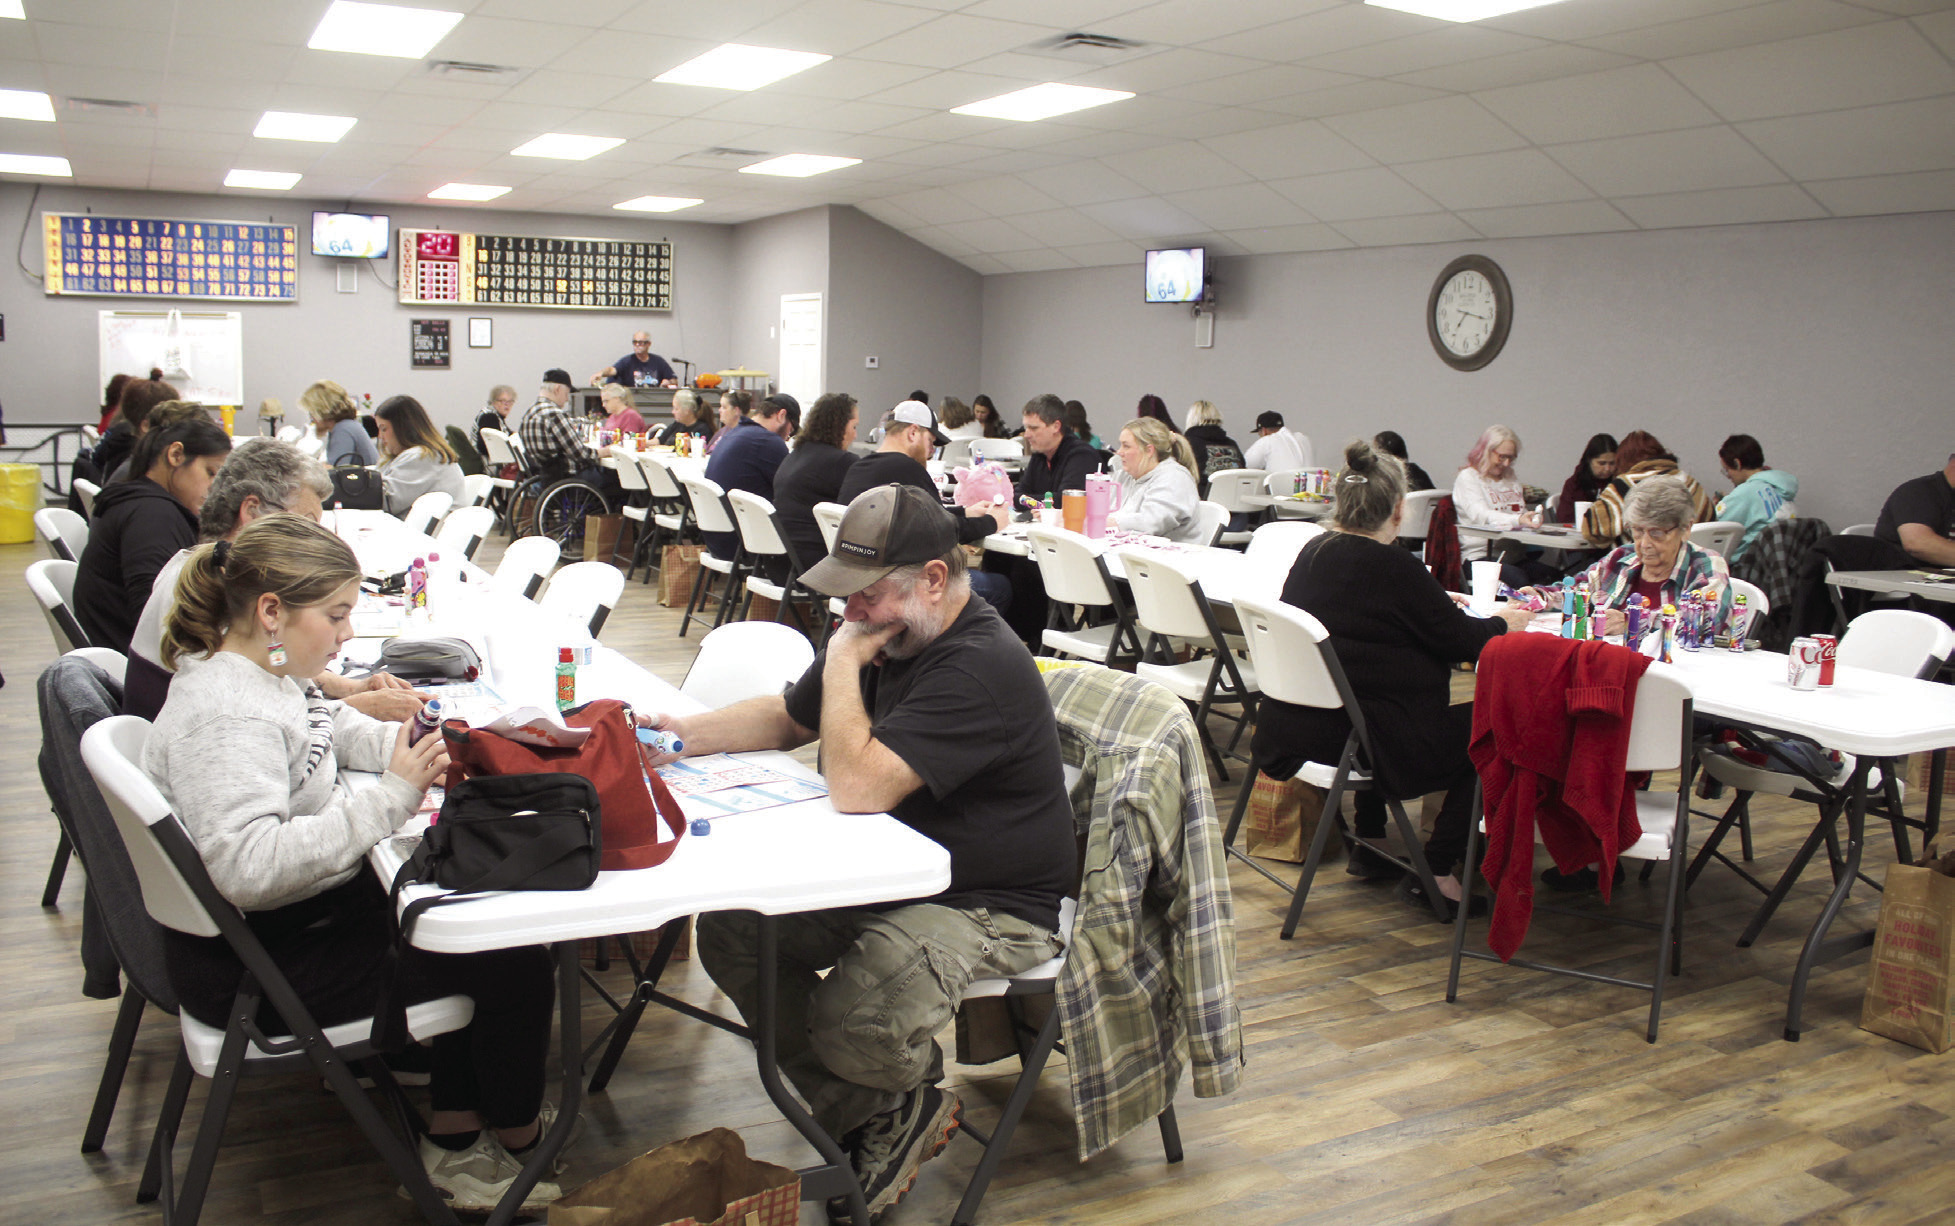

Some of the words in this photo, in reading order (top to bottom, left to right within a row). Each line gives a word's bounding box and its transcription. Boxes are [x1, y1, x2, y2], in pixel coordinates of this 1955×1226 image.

[329, 239, 352, 254] 64
[421, 232, 452, 254] 20
[481, 237, 486, 247] 1
[493, 238, 499, 248] 2
[507, 238, 512, 249] 3
[520, 239, 525, 249] 4
[533, 240, 538, 250] 5
[547, 240, 553, 250] 6
[560, 241, 566, 251] 7
[586, 242, 592, 252] 9
[597, 242, 607, 253] 10
[610, 243, 620, 253] 11
[623, 243, 633, 254] 12
[636, 244, 645, 254] 13
[648, 245, 658, 254] 14
[660, 245, 670, 255] 15
[478, 251, 487, 261] 16
[492, 251, 502, 261] 17
[519, 252, 529, 263] 19
[531, 253, 541, 263] 20
[544, 253, 555, 264] 21
[558, 253, 568, 264] 22
[571, 254, 580, 265] 23
[584, 254, 593, 265] 24
[596, 255, 606, 266] 25
[609, 256, 618, 266] 26
[621, 256, 631, 267] 27
[647, 258, 656, 268] 29
[660, 258, 670, 268] 30
[477, 264, 488, 274] 31
[490, 265, 501, 275] 32
[504, 265, 514, 275] 33
[518, 266, 527, 276] 34
[530, 266, 540, 276] 35
[557, 267, 568, 277] 37
[583, 268, 593, 279] 39
[609, 269, 619, 279] 41
[621, 269, 631, 280] 42
[634, 270, 644, 280] 43
[646, 271, 656, 280] 44
[659, 271, 669, 281] 45
[490, 278, 500, 288] 47
[517, 279, 527, 289] 49
[530, 279, 540, 290] 50
[544, 279, 555, 290] 51
[557, 280, 567, 292] 52
[570, 280, 580, 292] 53
[582, 281, 593, 292] 54
[596, 281, 605, 292] 55
[608, 282, 618, 292] 56
[621, 282, 631, 293] 57
[634, 282, 643, 293] 58
[646, 283, 656, 294] 59
[659, 284, 669, 294] 60
[1158, 280, 1176, 299] 64
[476, 291, 488, 302] 61
[490, 291, 501, 302] 62
[504, 292, 515, 303] 63
[517, 292, 528, 303] 64
[530, 293, 541, 303] 65
[557, 293, 568, 304] 67
[583, 294, 593, 305] 69
[596, 294, 606, 305] 70
[609, 294, 618, 305] 71
[621, 295, 632, 306] 72
[634, 295, 644, 306] 73
[647, 296, 656, 306] 74
[659, 297, 669, 307] 75
[1894, 920, 1937, 940] HOLIDAY
[1884, 932, 1942, 958] FAVORITES
